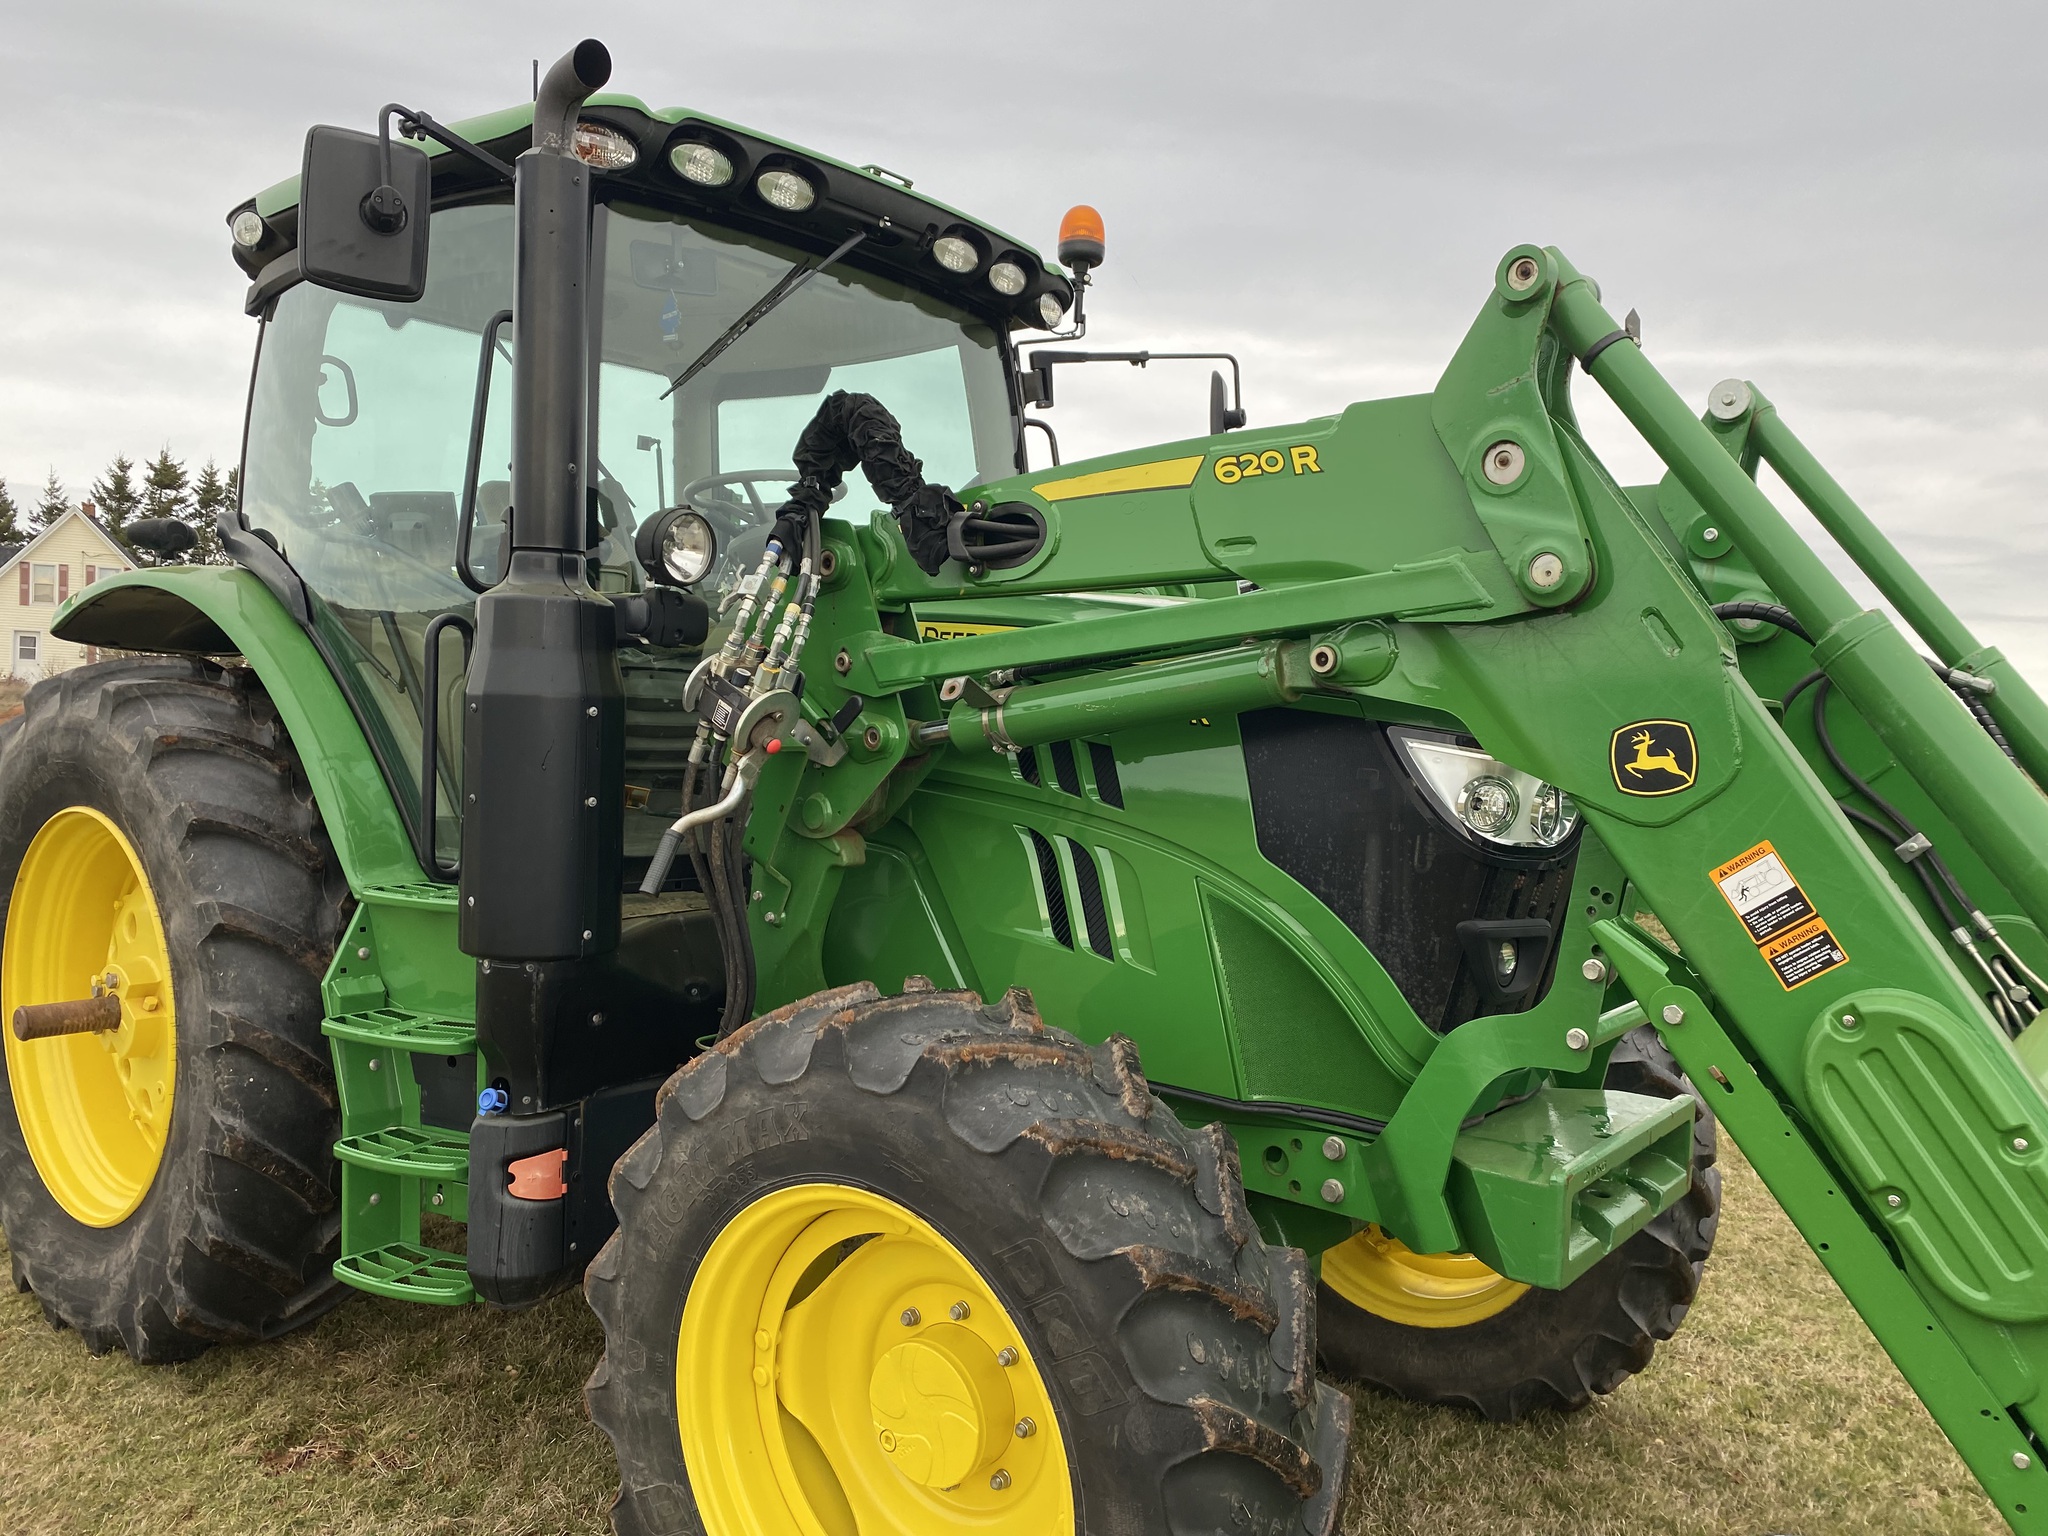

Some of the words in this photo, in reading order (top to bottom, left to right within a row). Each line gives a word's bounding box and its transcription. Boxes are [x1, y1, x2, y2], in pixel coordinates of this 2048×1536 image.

[1214, 449, 1285, 485] 620
[1288, 444, 1324, 476] R
[1727, 847, 1766, 873] WARNING
[1779, 924, 1820, 950] WARNING
[644, 1141, 720, 1262] AGRI
[720, 1101, 809, 1167] MAX
[727, 1160, 757, 1192] 855
